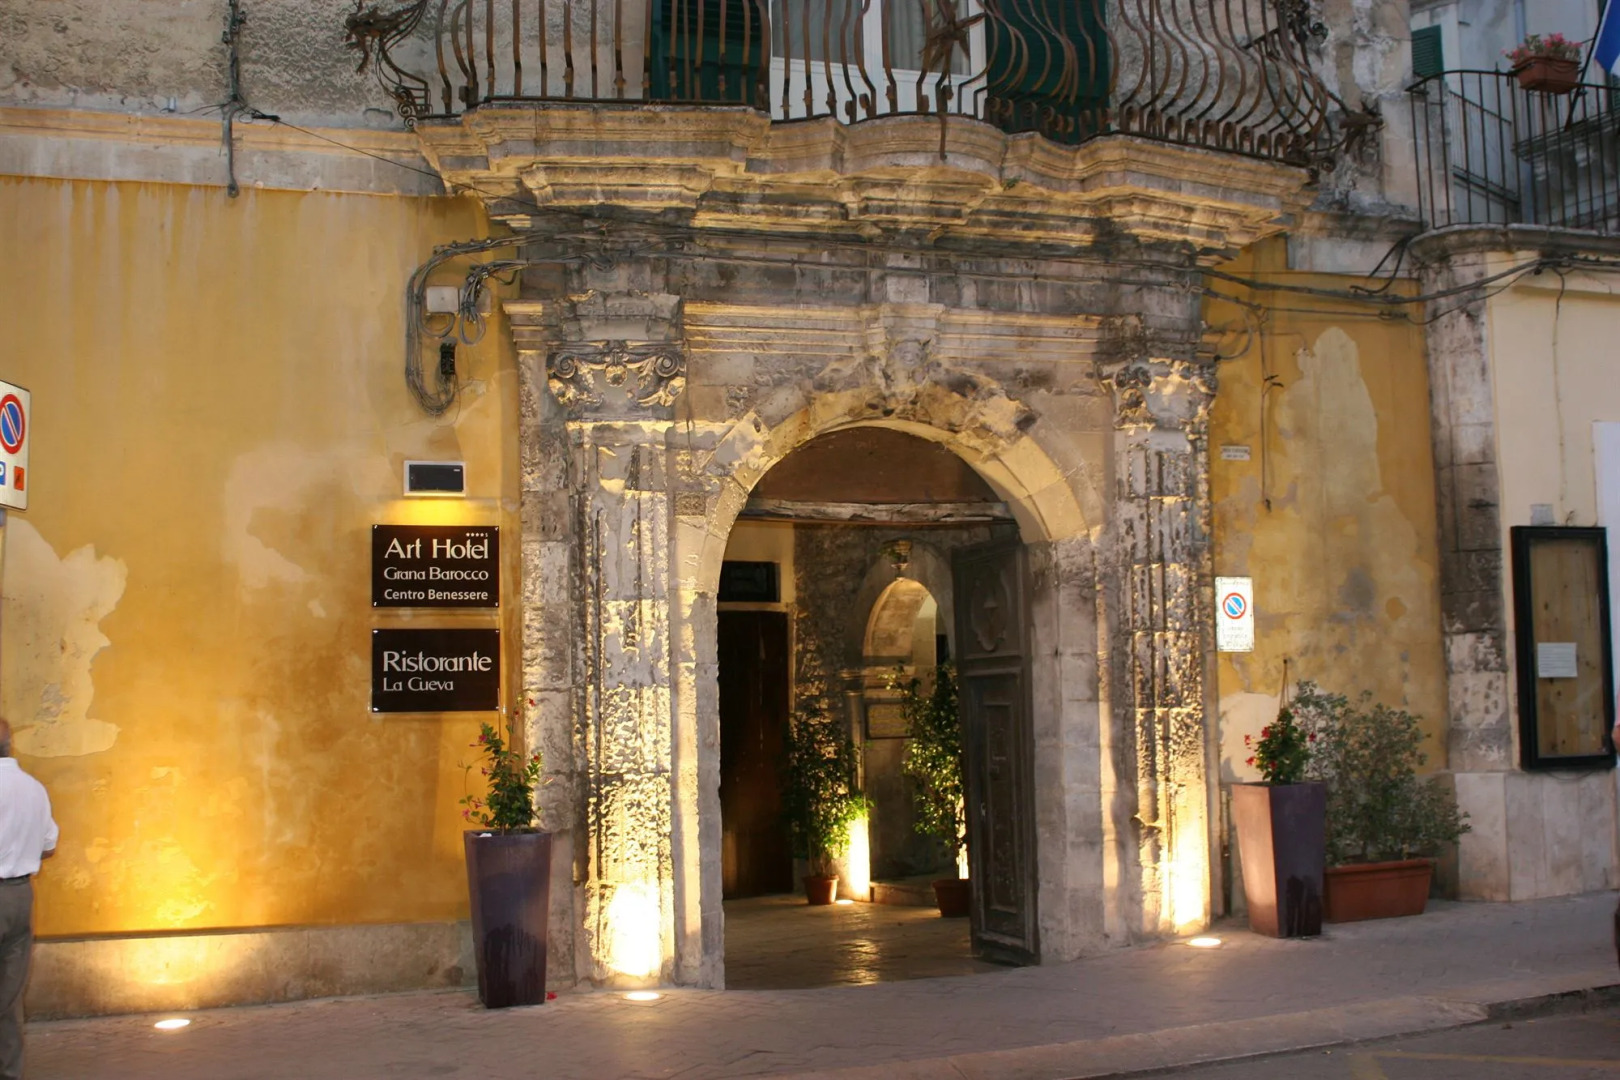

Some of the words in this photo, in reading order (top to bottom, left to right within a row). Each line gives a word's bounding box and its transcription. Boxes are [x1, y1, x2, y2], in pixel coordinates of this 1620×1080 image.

[384, 537, 421, 559] Art
[432, 538, 489, 559] Hotel
[383, 566, 426, 580] Grana
[429, 566, 489, 580] Barocco
[384, 588, 425, 600] Centro
[428, 588, 489, 600] Benessere
[383, 650, 492, 672] Ristorante
[383, 677, 402, 691] La
[407, 676, 454, 691] Cueva
